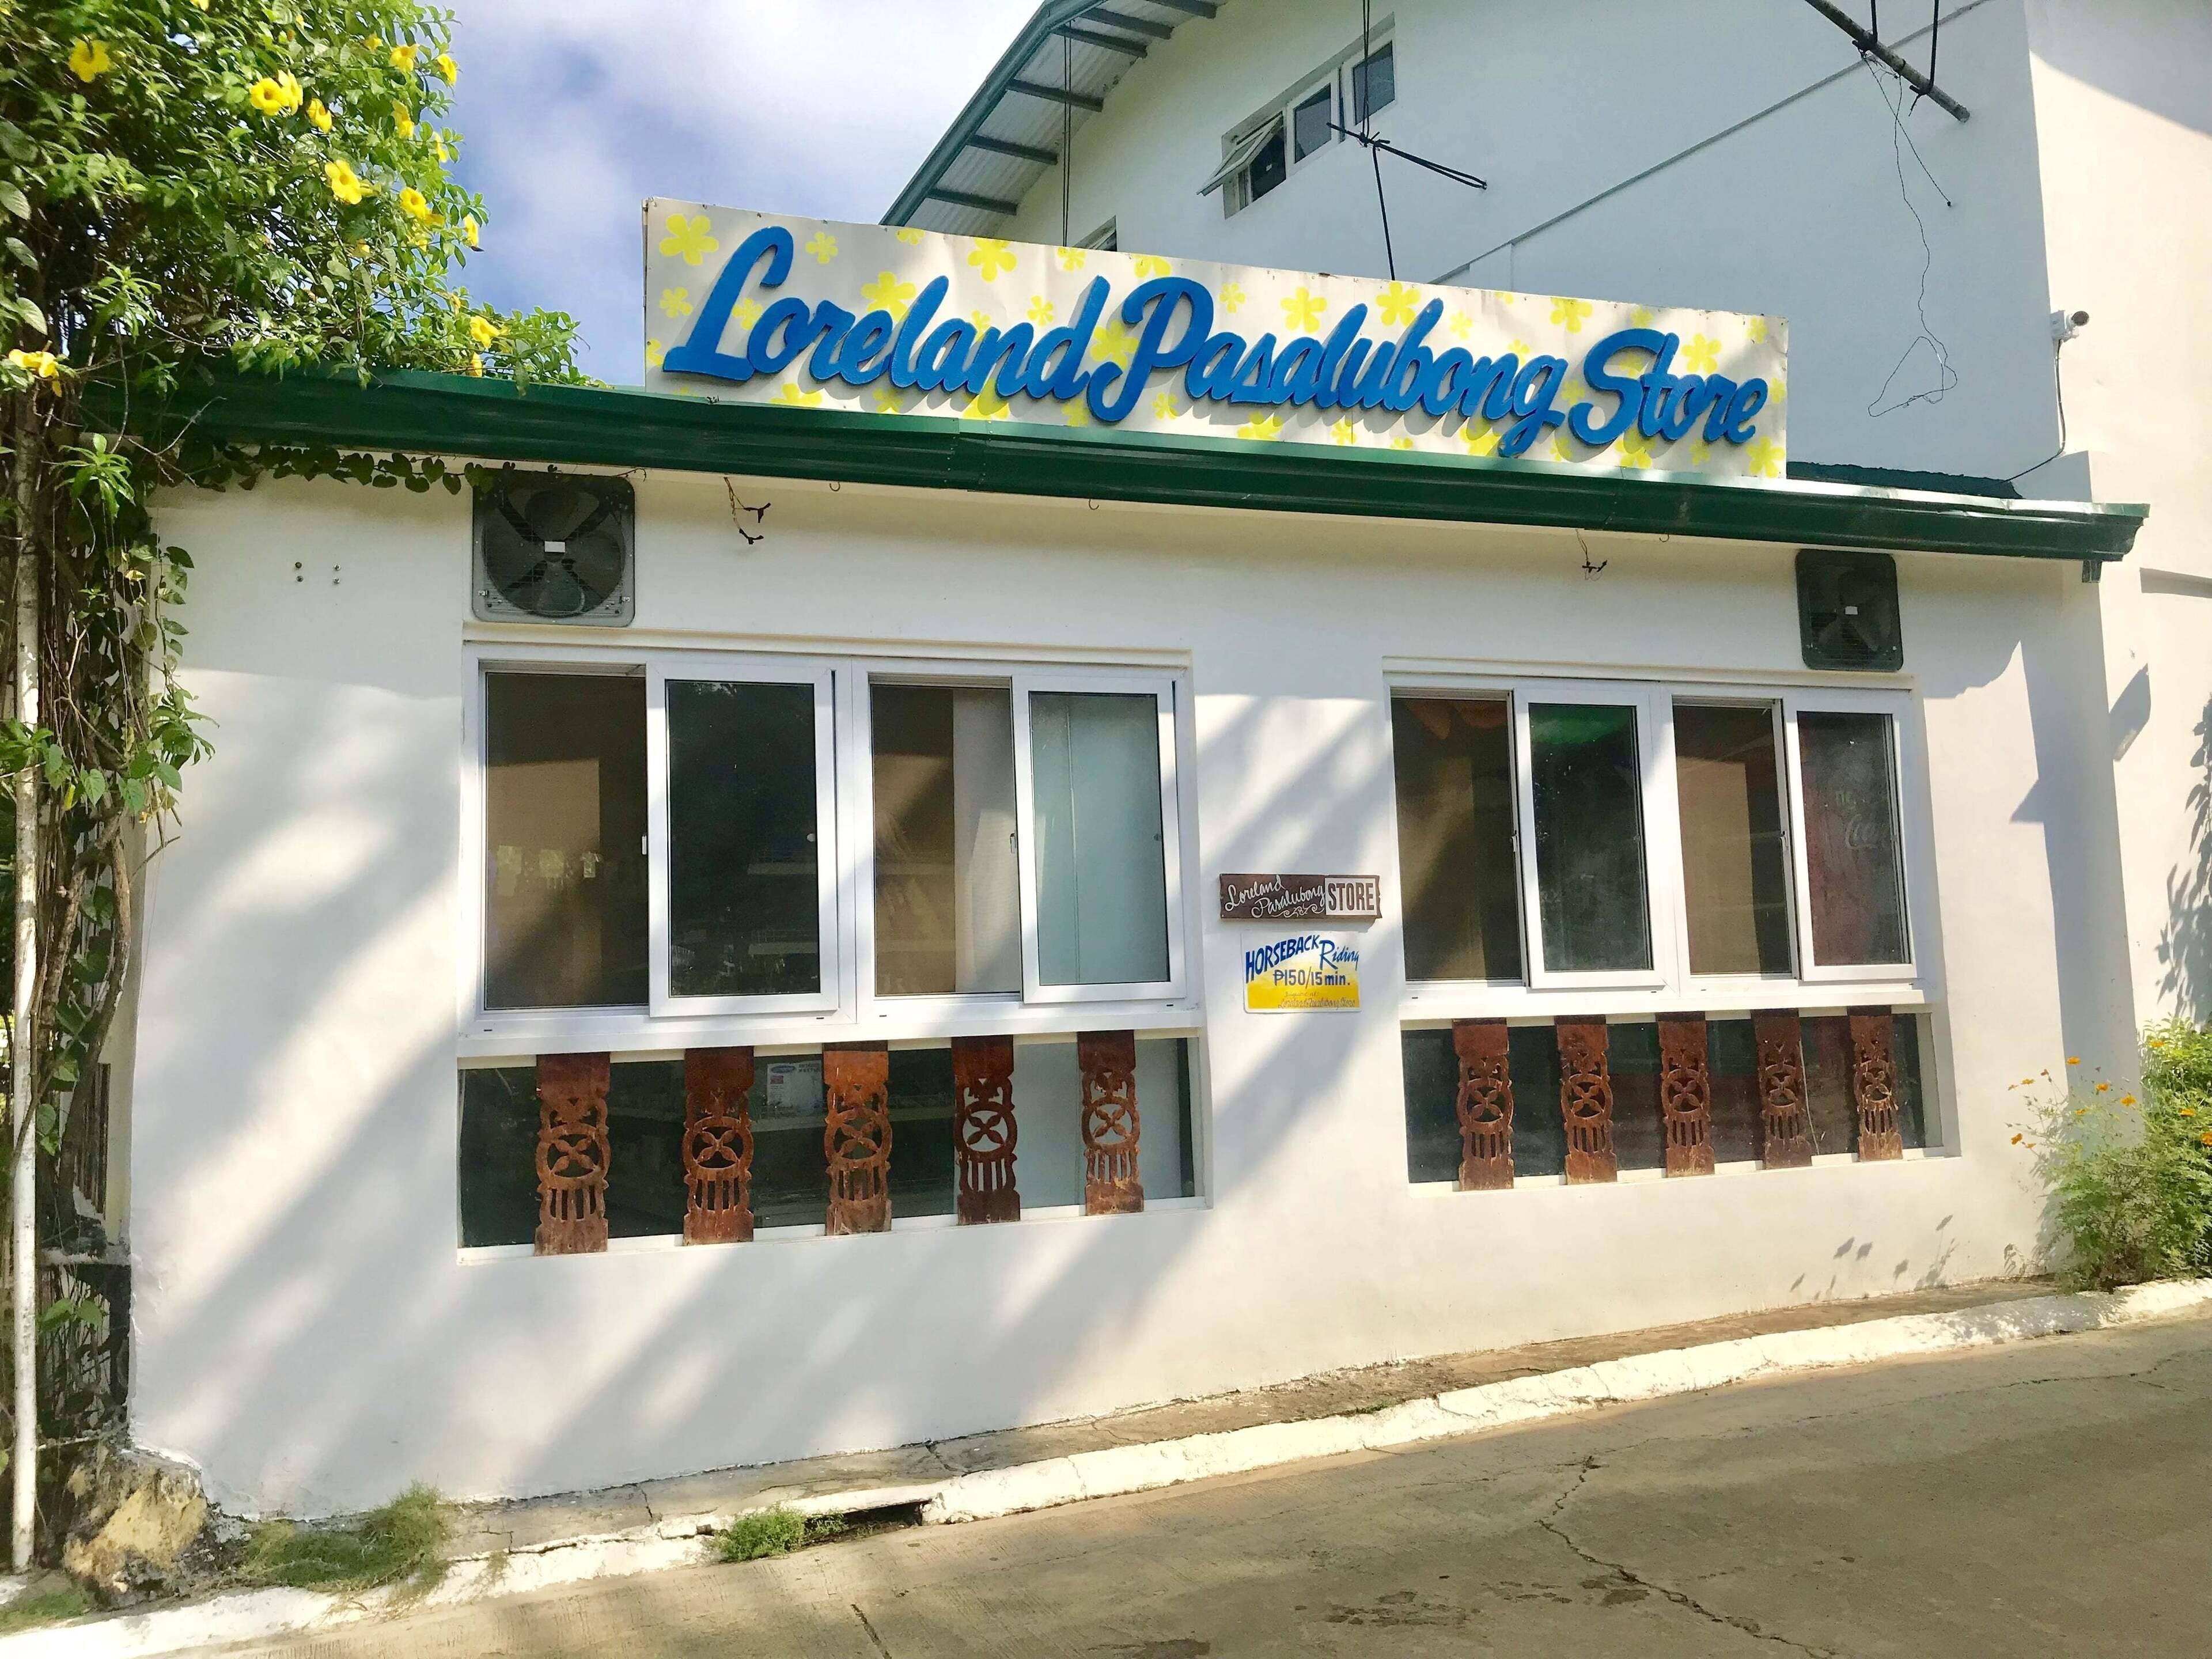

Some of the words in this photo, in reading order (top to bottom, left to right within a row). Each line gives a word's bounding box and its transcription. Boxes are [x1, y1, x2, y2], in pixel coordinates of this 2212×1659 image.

[663, 225, 1111, 400] Loreland
[1086, 277, 1566, 459] Pasalubong
[1567, 328, 1768, 445] Store
[1225, 875, 1286, 912] Loreland
[1251, 885, 1325, 918] Pasalubong
[1327, 882, 1374, 911] STORE
[1245, 934, 1320, 983] HORSEBACK
[1319, 940, 1359, 971] Riding
[1324, 971, 1350, 986] min.
